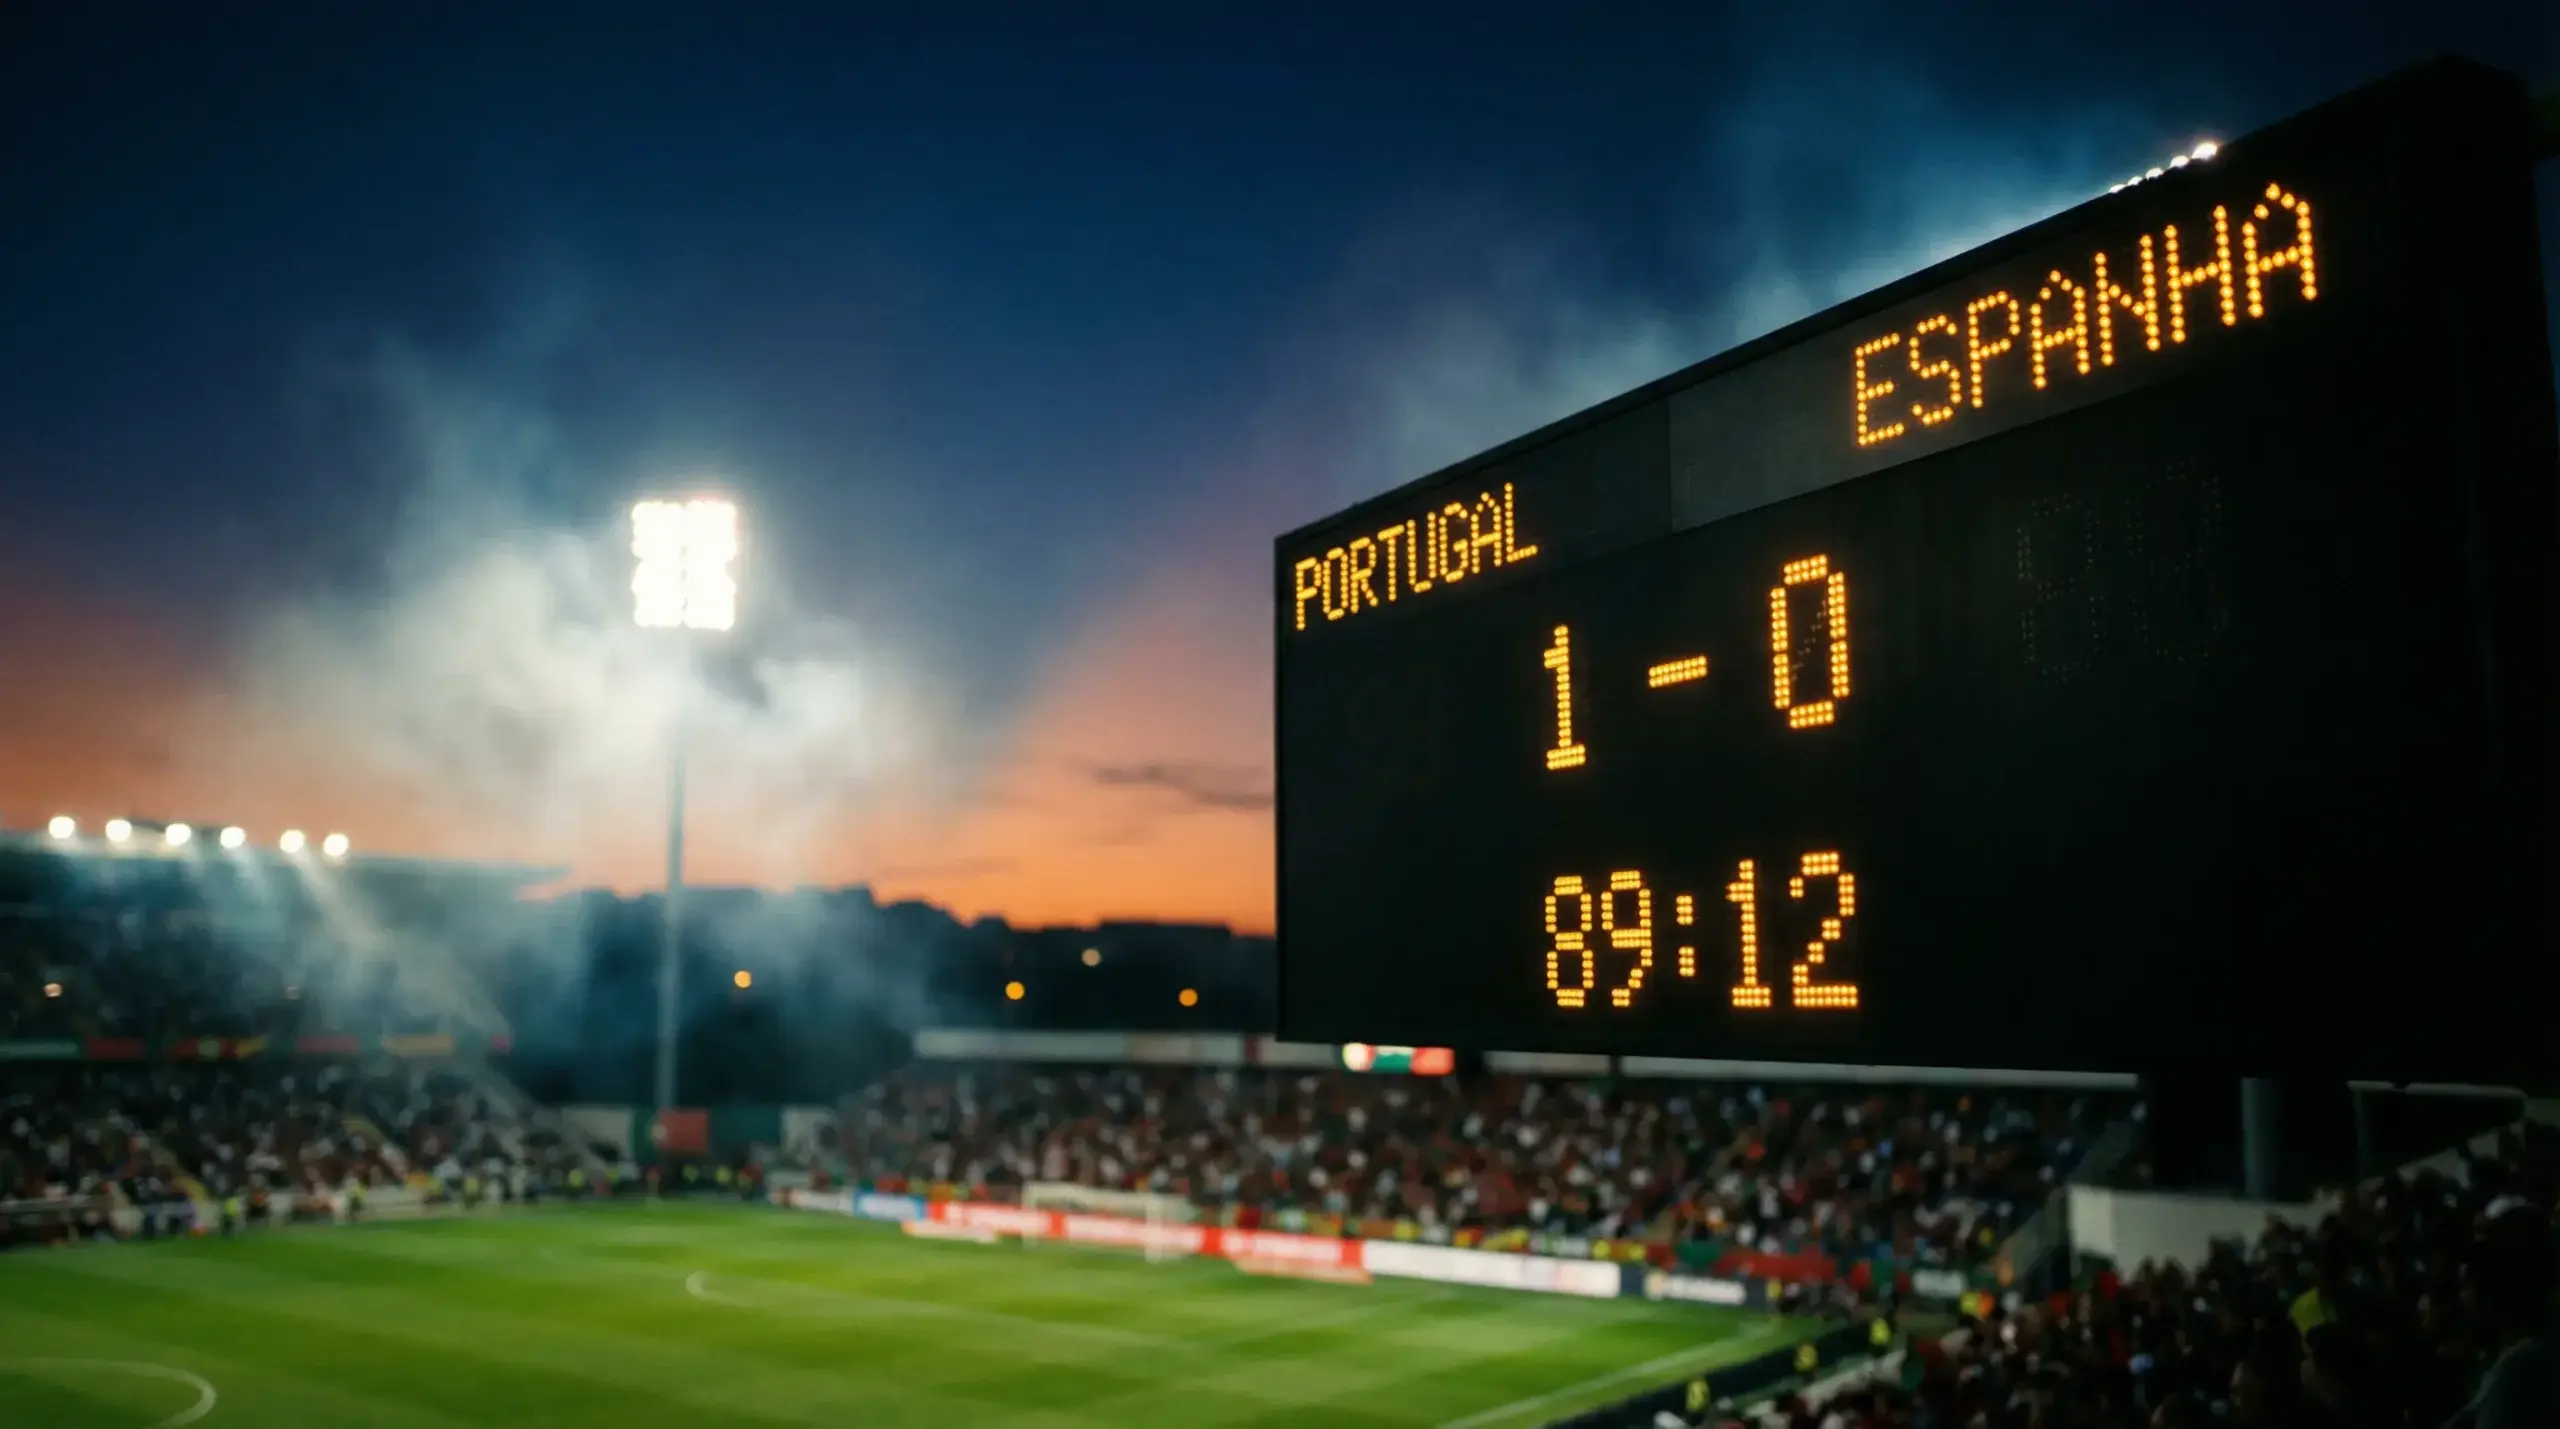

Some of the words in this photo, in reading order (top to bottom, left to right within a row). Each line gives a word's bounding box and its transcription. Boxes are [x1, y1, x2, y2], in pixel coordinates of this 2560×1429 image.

[1854, 182, 2318, 447] ESPANHA
[1294, 481, 1539, 631] PORTUGAL
[1542, 624, 1586, 770] 1
[1768, 553, 1850, 729] 0
[1543, 850, 1859, 1009] 89:12
